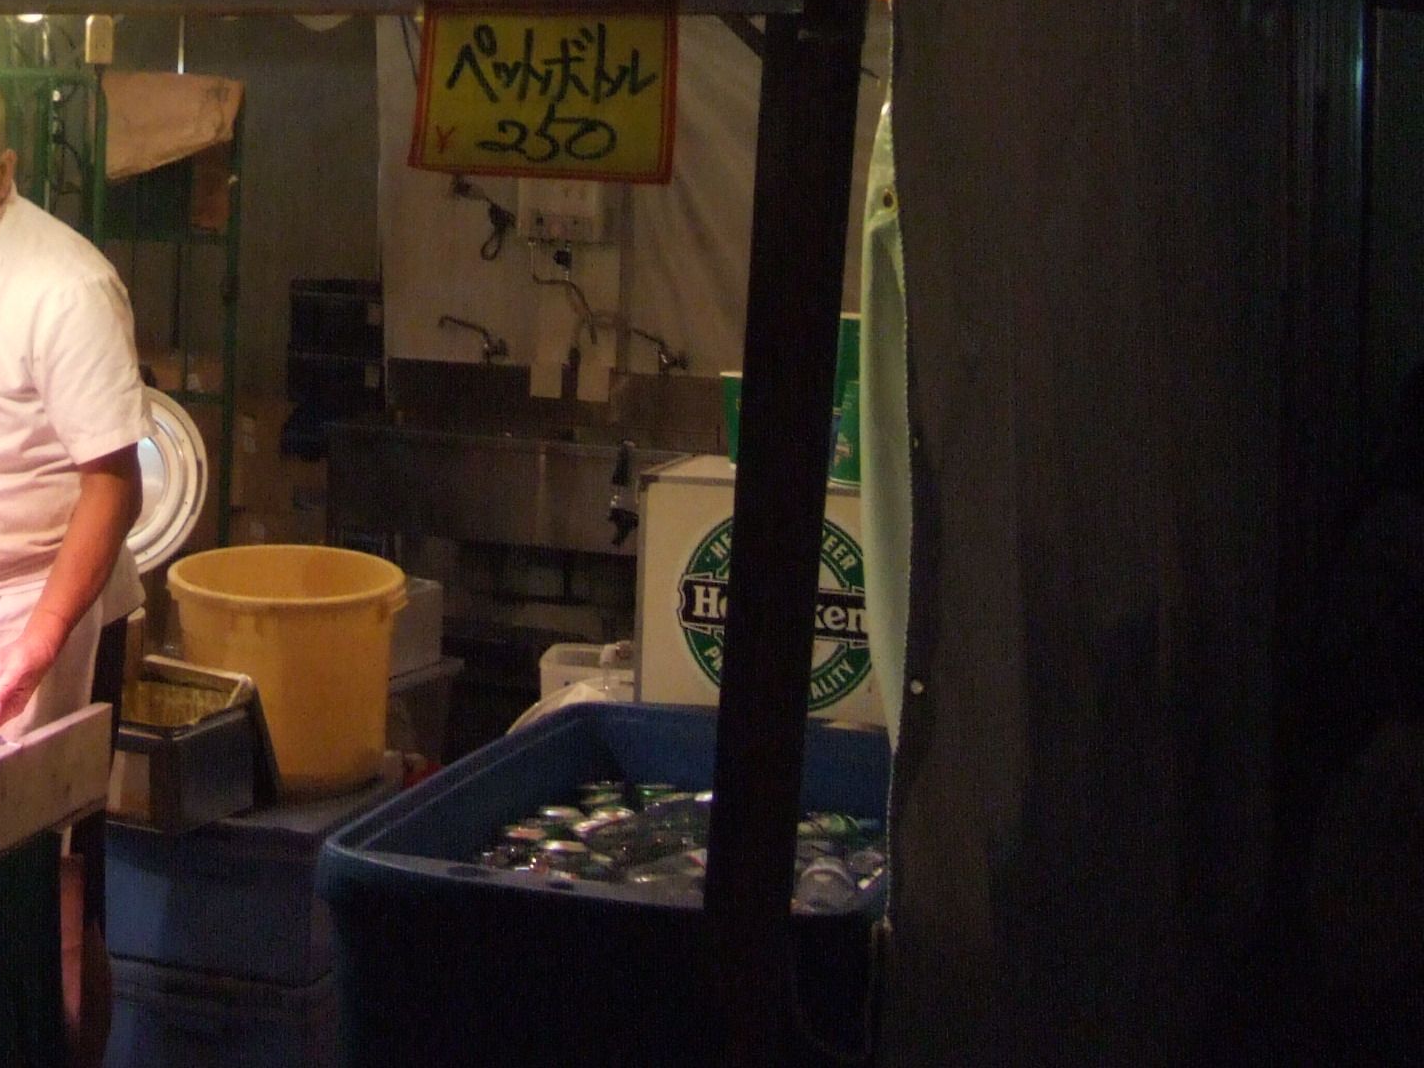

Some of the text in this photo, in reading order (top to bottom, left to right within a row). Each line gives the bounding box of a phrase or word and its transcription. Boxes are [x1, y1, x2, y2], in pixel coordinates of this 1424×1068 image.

[446, 22, 657, 104] ペットボトル
[476, 103, 618, 163] 250
